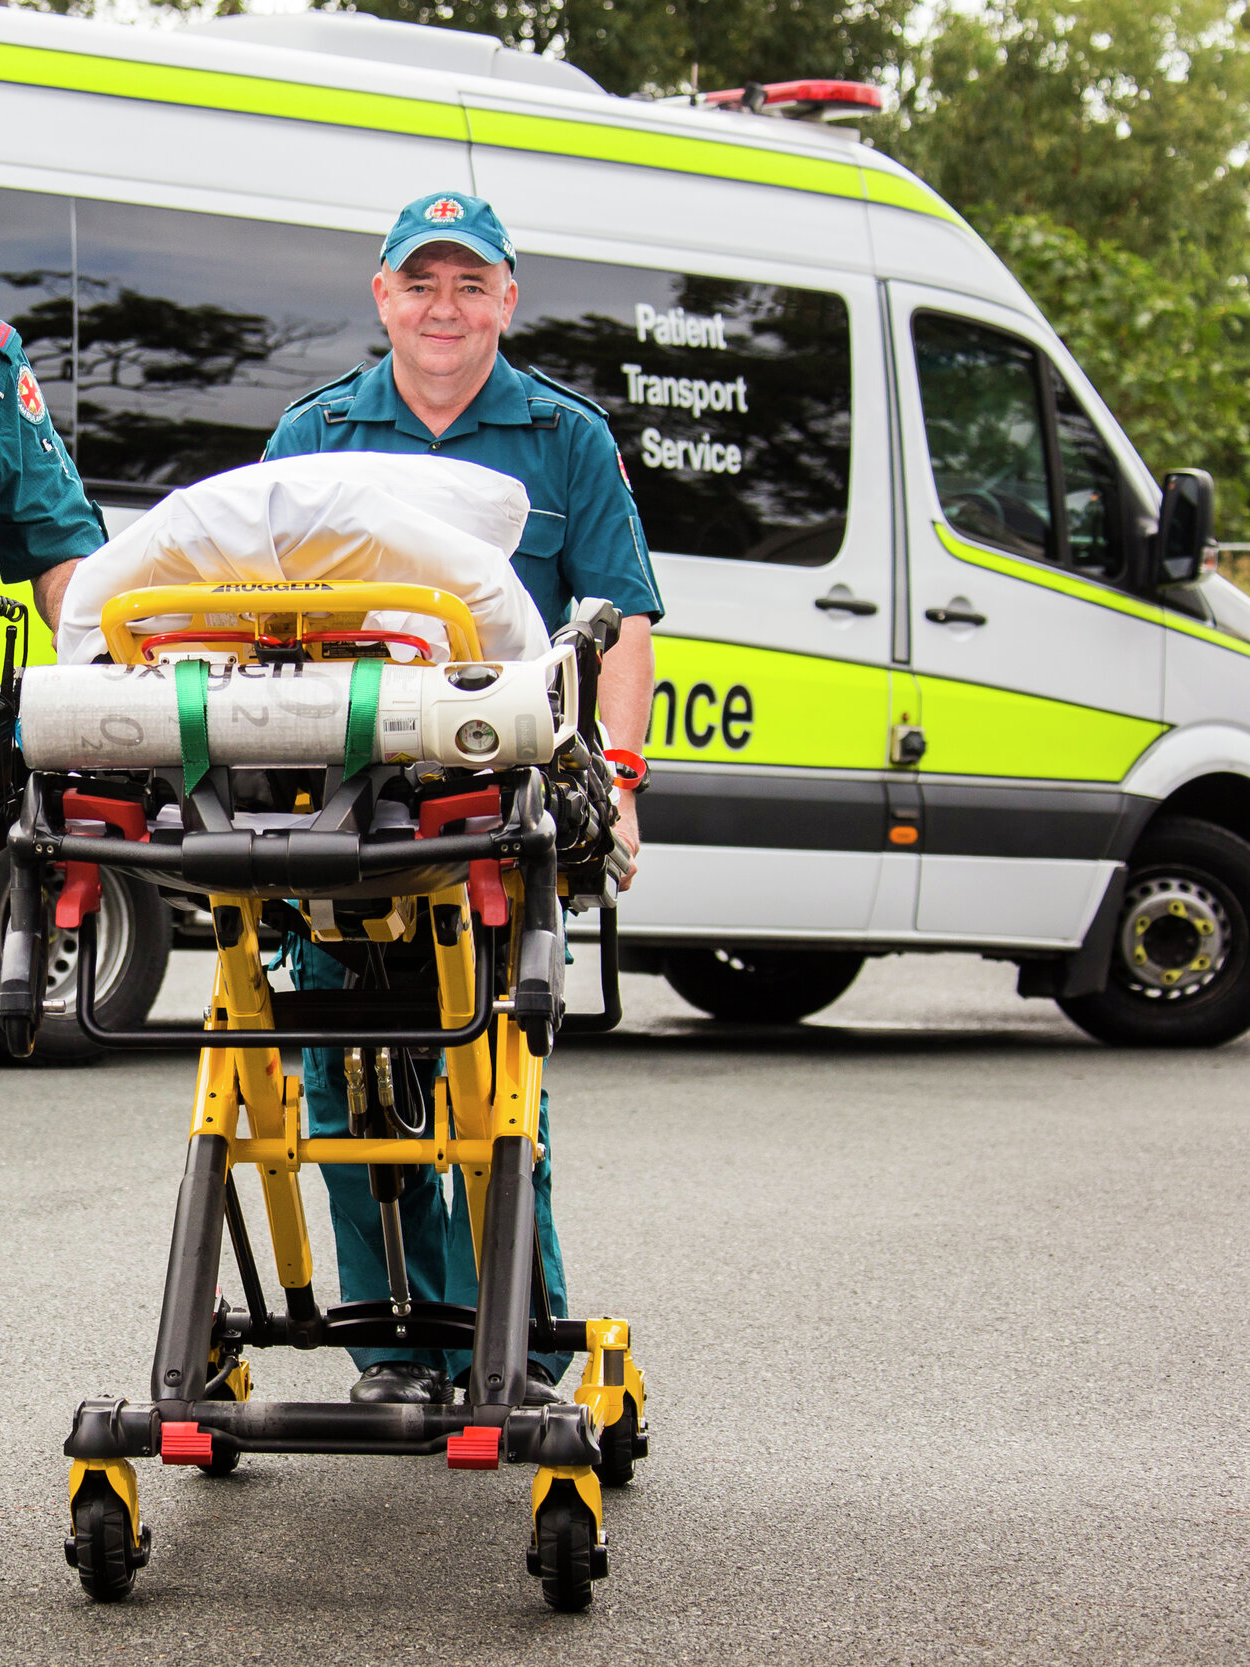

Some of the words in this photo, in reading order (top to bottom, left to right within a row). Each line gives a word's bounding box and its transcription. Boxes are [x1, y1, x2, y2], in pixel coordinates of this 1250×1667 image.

[635, 303, 727, 350] Patient
[621, 363, 749, 418] Transport
[641, 427, 742, 475] Service
[225, 583, 321, 592] RUGGED
